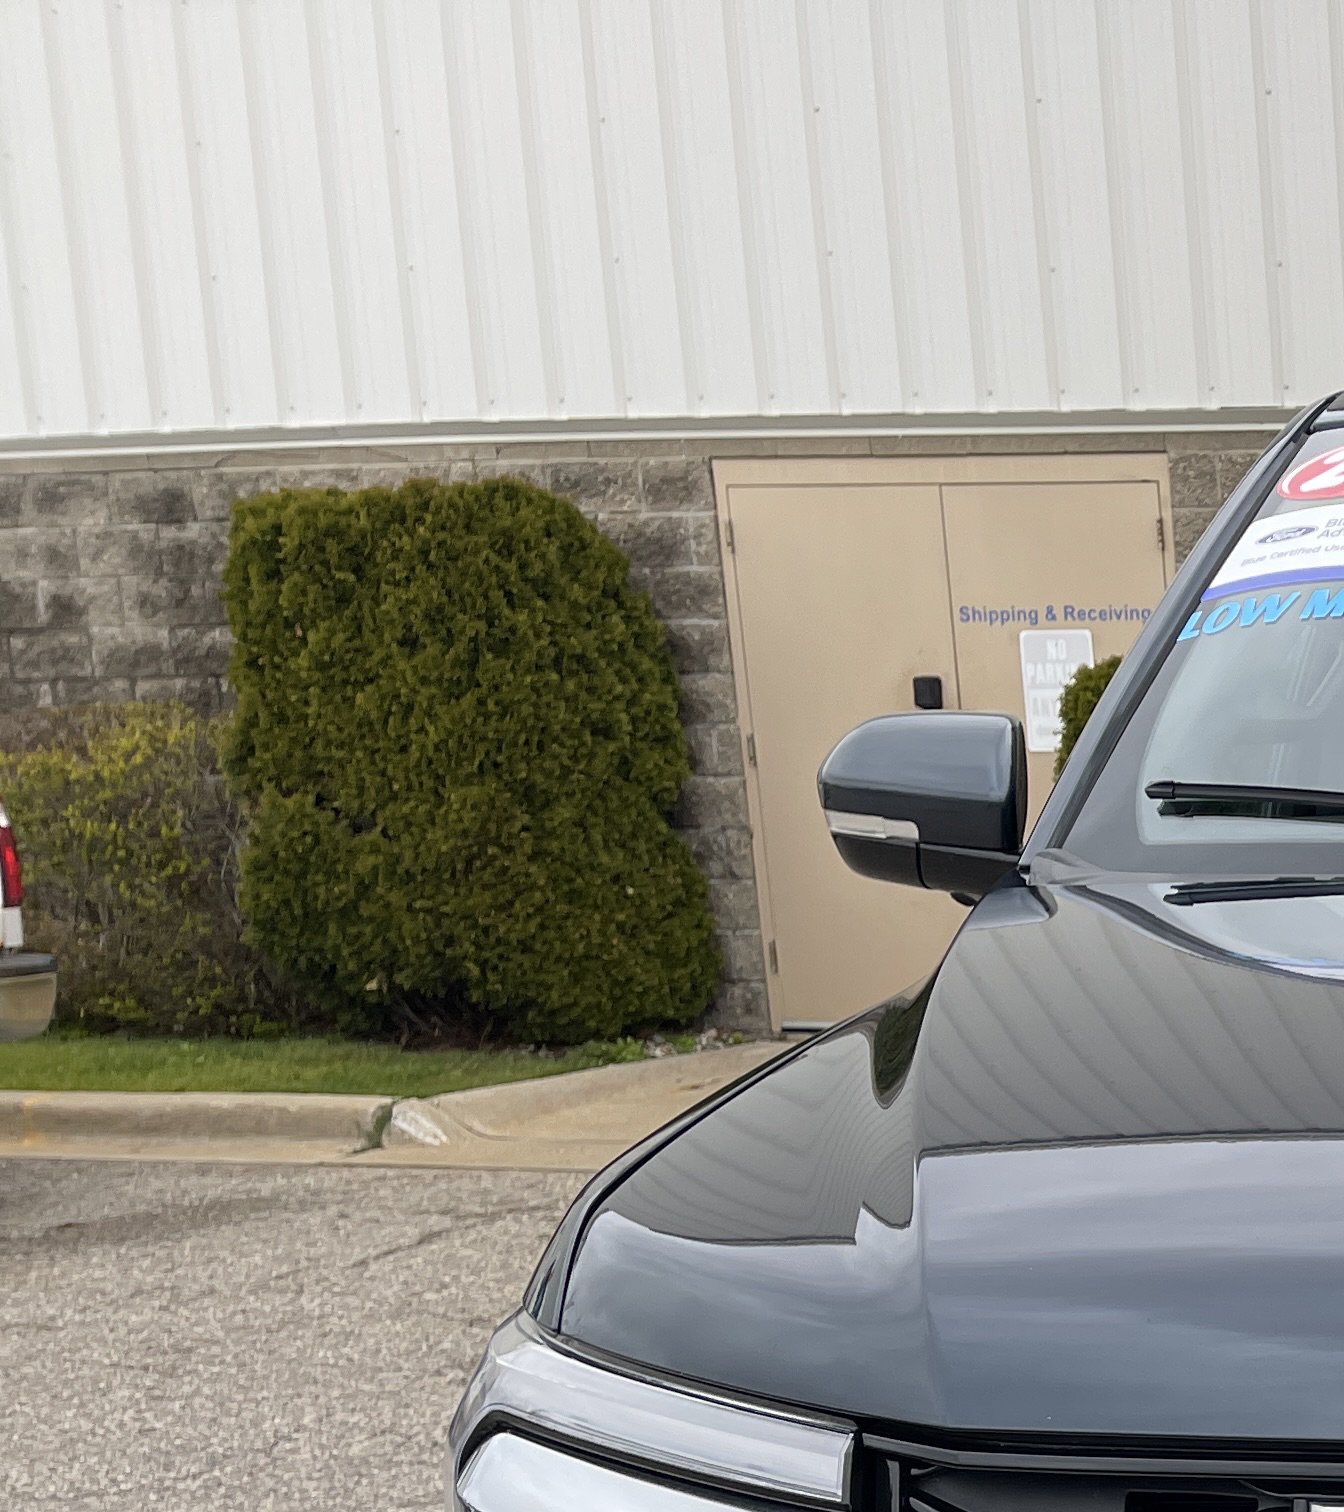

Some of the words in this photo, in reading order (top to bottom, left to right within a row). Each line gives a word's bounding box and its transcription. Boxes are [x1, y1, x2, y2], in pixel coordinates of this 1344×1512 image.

[1269, 545, 1322, 560] Certified
[959, 605, 1039, 625] Shipping
[1044, 604, 1057, 621] &
[1063, 603, 1151, 624] Receiving
[1176, 591, 1301, 642] LOW
[1045, 638, 1067, 660] NO
